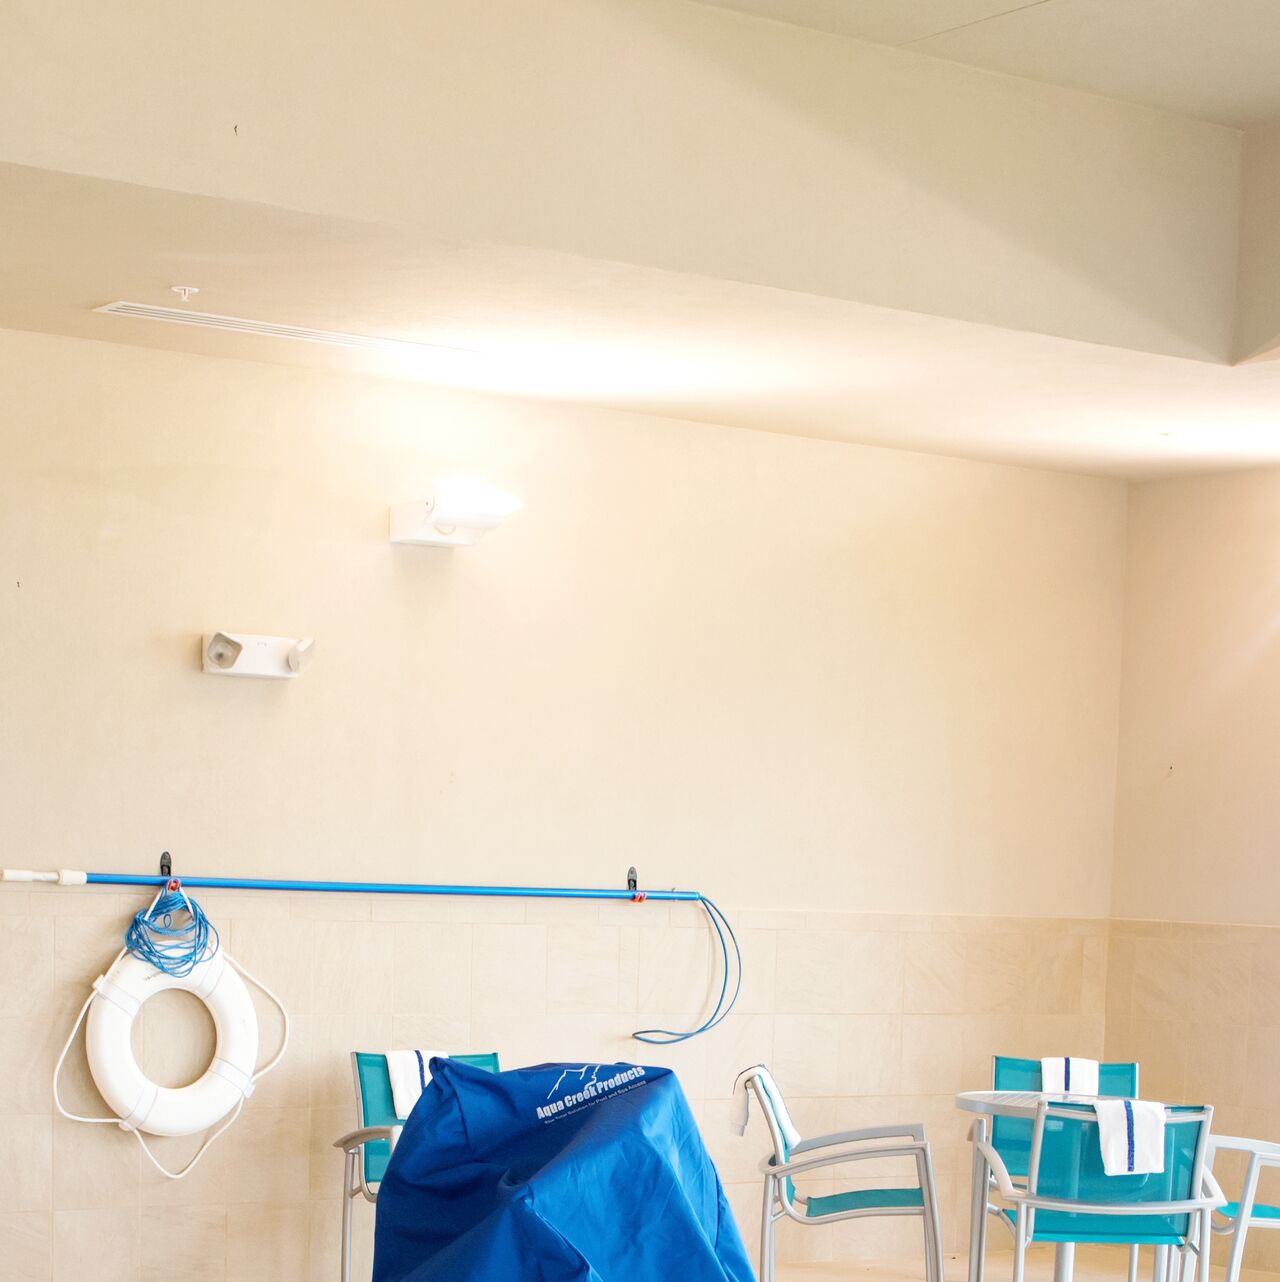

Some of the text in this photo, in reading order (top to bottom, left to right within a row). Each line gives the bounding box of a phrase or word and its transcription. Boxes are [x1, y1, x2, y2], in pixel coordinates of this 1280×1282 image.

[536, 1066, 645, 1119] Aqua Creek Products
